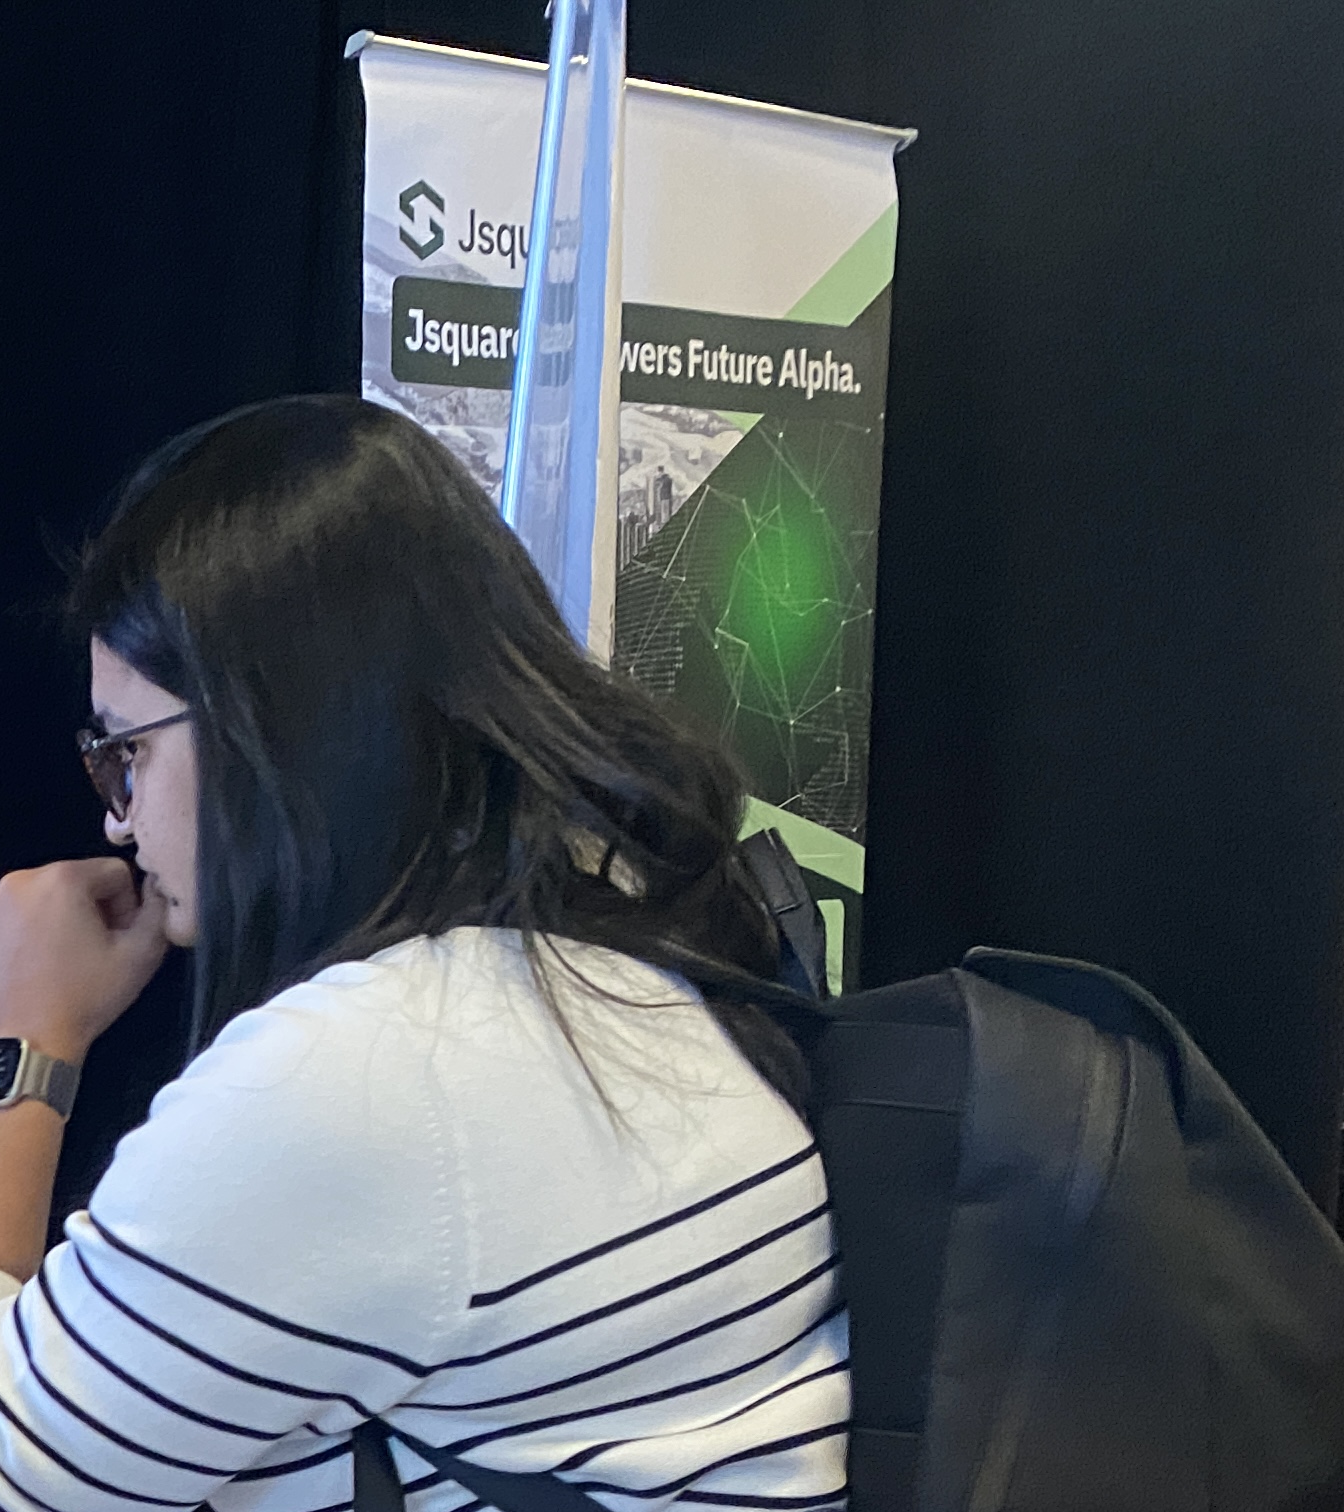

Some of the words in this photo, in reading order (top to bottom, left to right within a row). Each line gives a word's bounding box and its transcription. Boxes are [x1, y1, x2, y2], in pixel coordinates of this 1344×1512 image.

[458, 208, 528, 269] Jsqu
[619, 341, 683, 377] wers
[688, 338, 774, 386] Future
[778, 347, 862, 400] Alpha.
